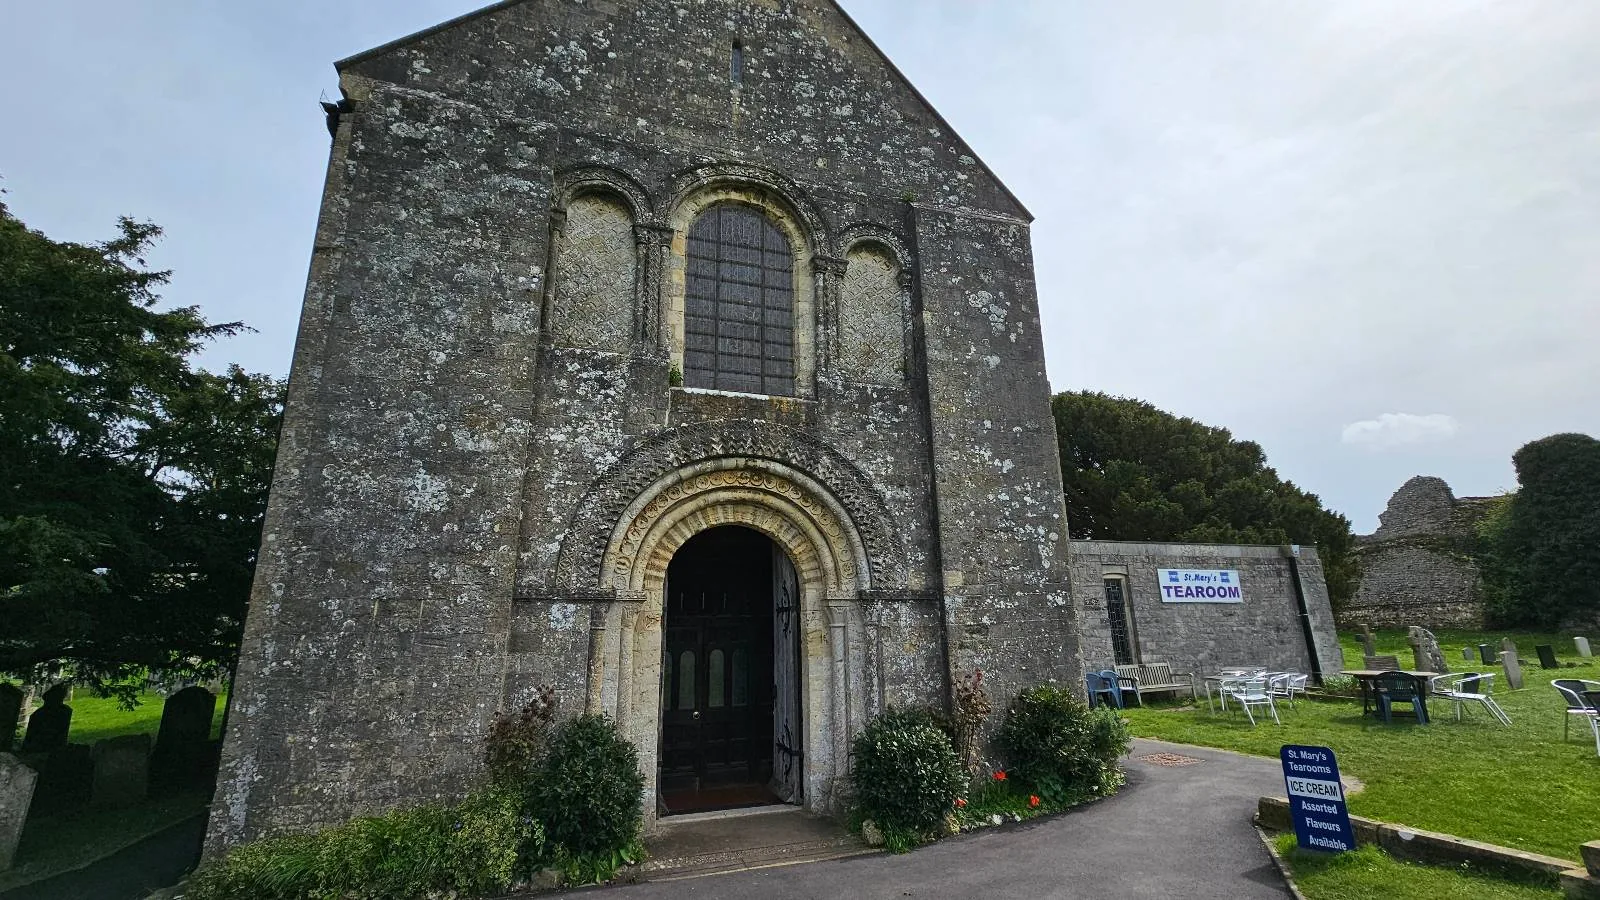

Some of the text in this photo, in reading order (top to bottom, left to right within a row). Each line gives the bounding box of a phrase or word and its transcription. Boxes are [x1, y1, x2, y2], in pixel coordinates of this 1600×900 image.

[1162, 585, 1240, 598] TEAROOM
[1288, 749, 1327, 762] St. Mary's
[1288, 761, 1331, 774] Tearooms
[1290, 780, 1338, 797] ICE CREAM
[1302, 800, 1338, 815] Assorted
[1305, 816, 1341, 832] Flavours
[1309, 834, 1347, 851] Available
